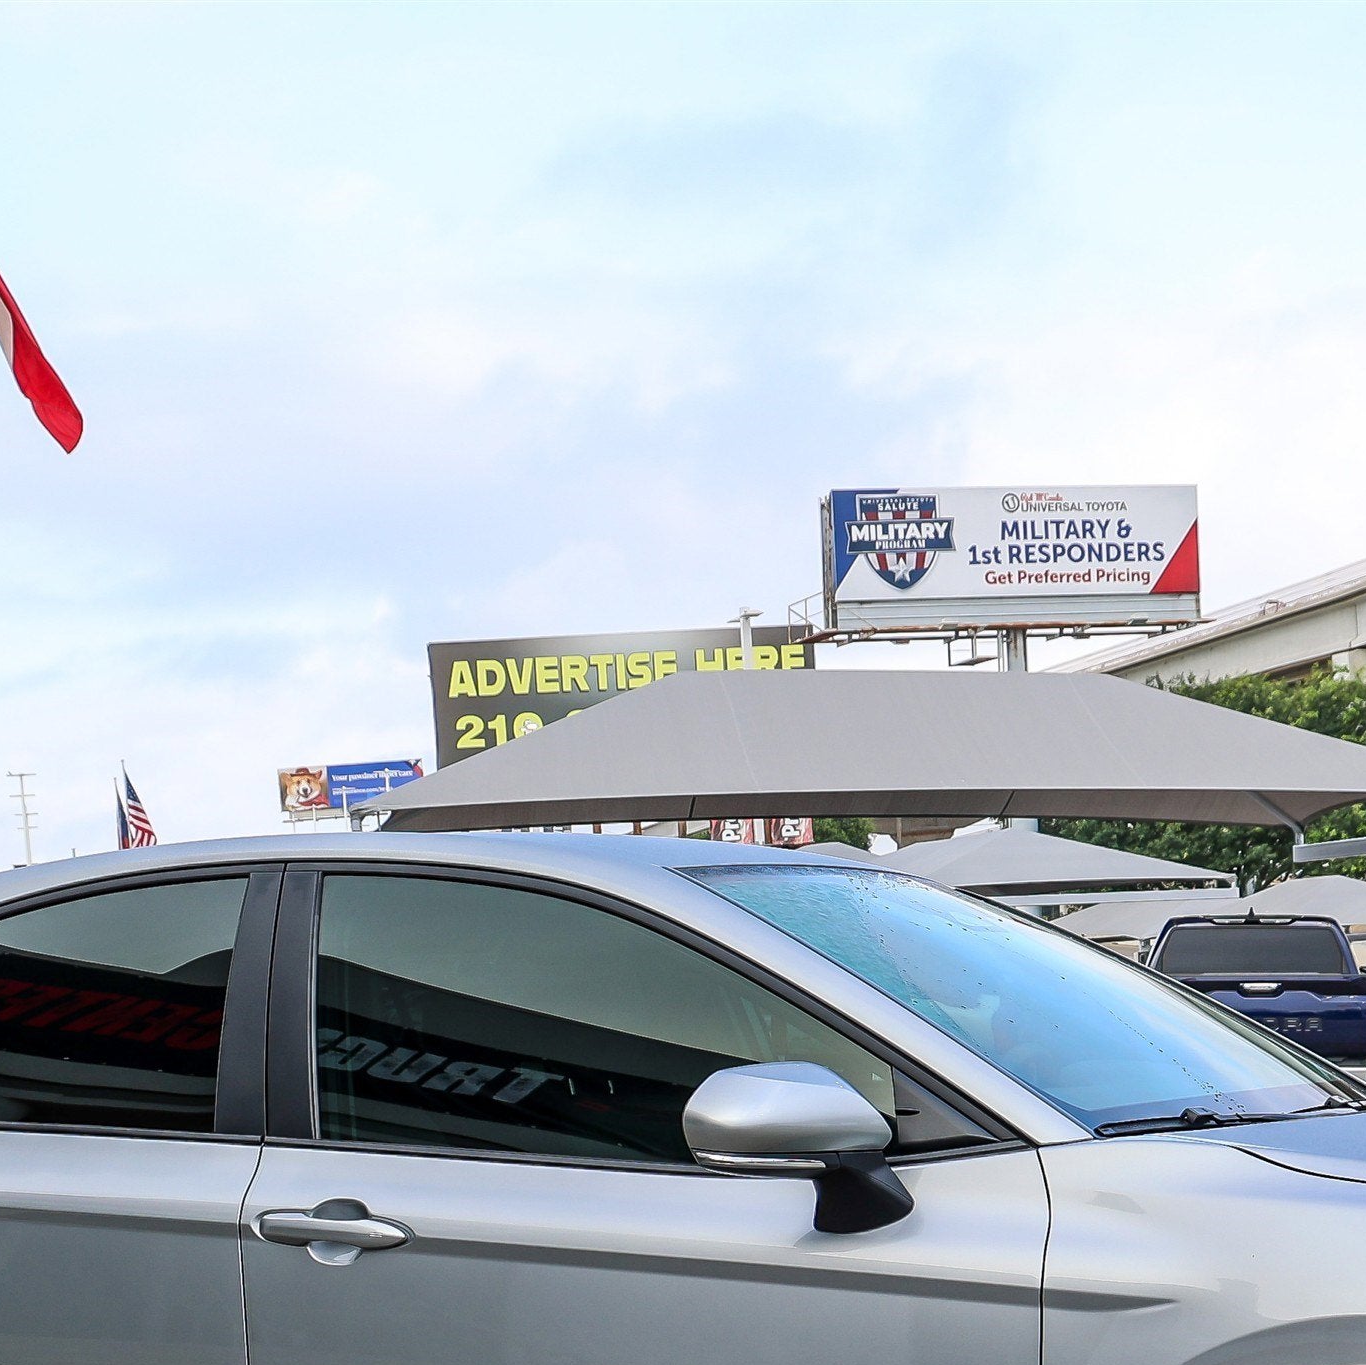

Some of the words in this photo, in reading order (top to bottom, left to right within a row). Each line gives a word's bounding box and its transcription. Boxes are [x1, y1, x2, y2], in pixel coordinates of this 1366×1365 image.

[877, 502, 919, 511] SALUTE
[1021, 501, 1083, 512] UNIVERSAL
[1085, 501, 1127, 511] TOYOTA
[851, 522, 949, 542] MILITARY
[1000, 518, 1111, 541] MILITARY
[1116, 518, 1133, 538] &
[875, 540, 926, 549] PROGRAM
[968, 545, 1003, 565] 1st
[1008, 541, 1165, 564] RESPONDERS
[985, 570, 1013, 584] Get
[1017, 569, 1092, 584] Preferred
[1096, 568, 1151, 585] Pricing
